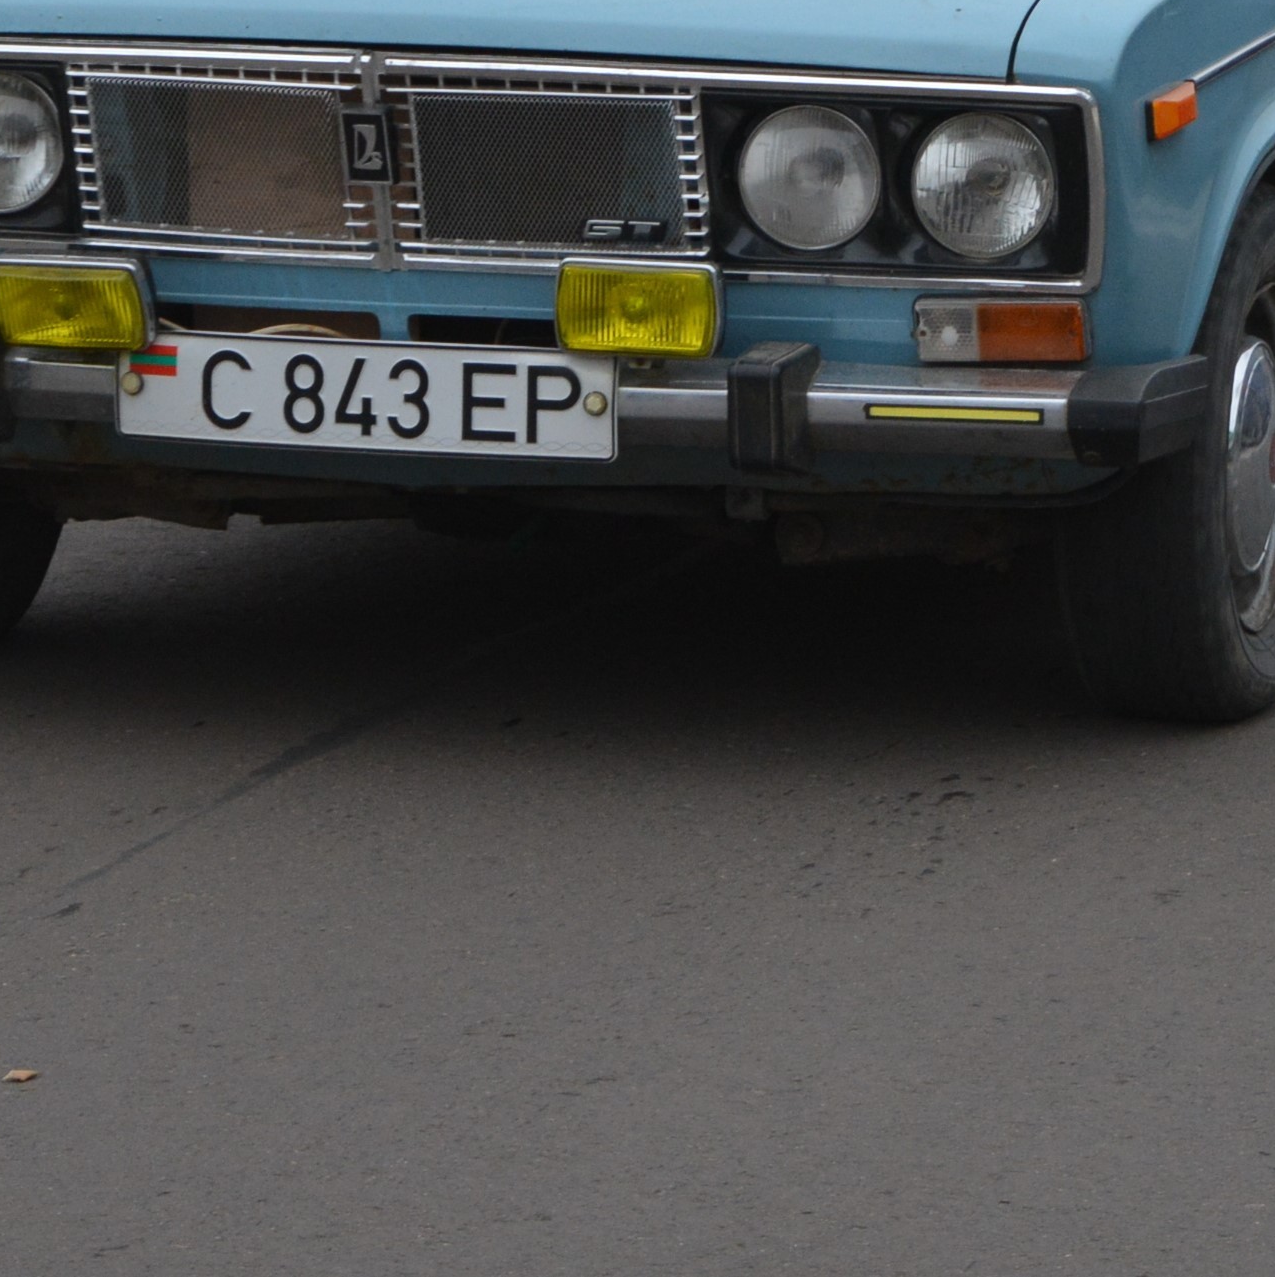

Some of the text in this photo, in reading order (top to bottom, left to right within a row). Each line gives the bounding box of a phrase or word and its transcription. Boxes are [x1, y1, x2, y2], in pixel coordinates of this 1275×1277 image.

[201, 349, 583, 444] C 843 EP
